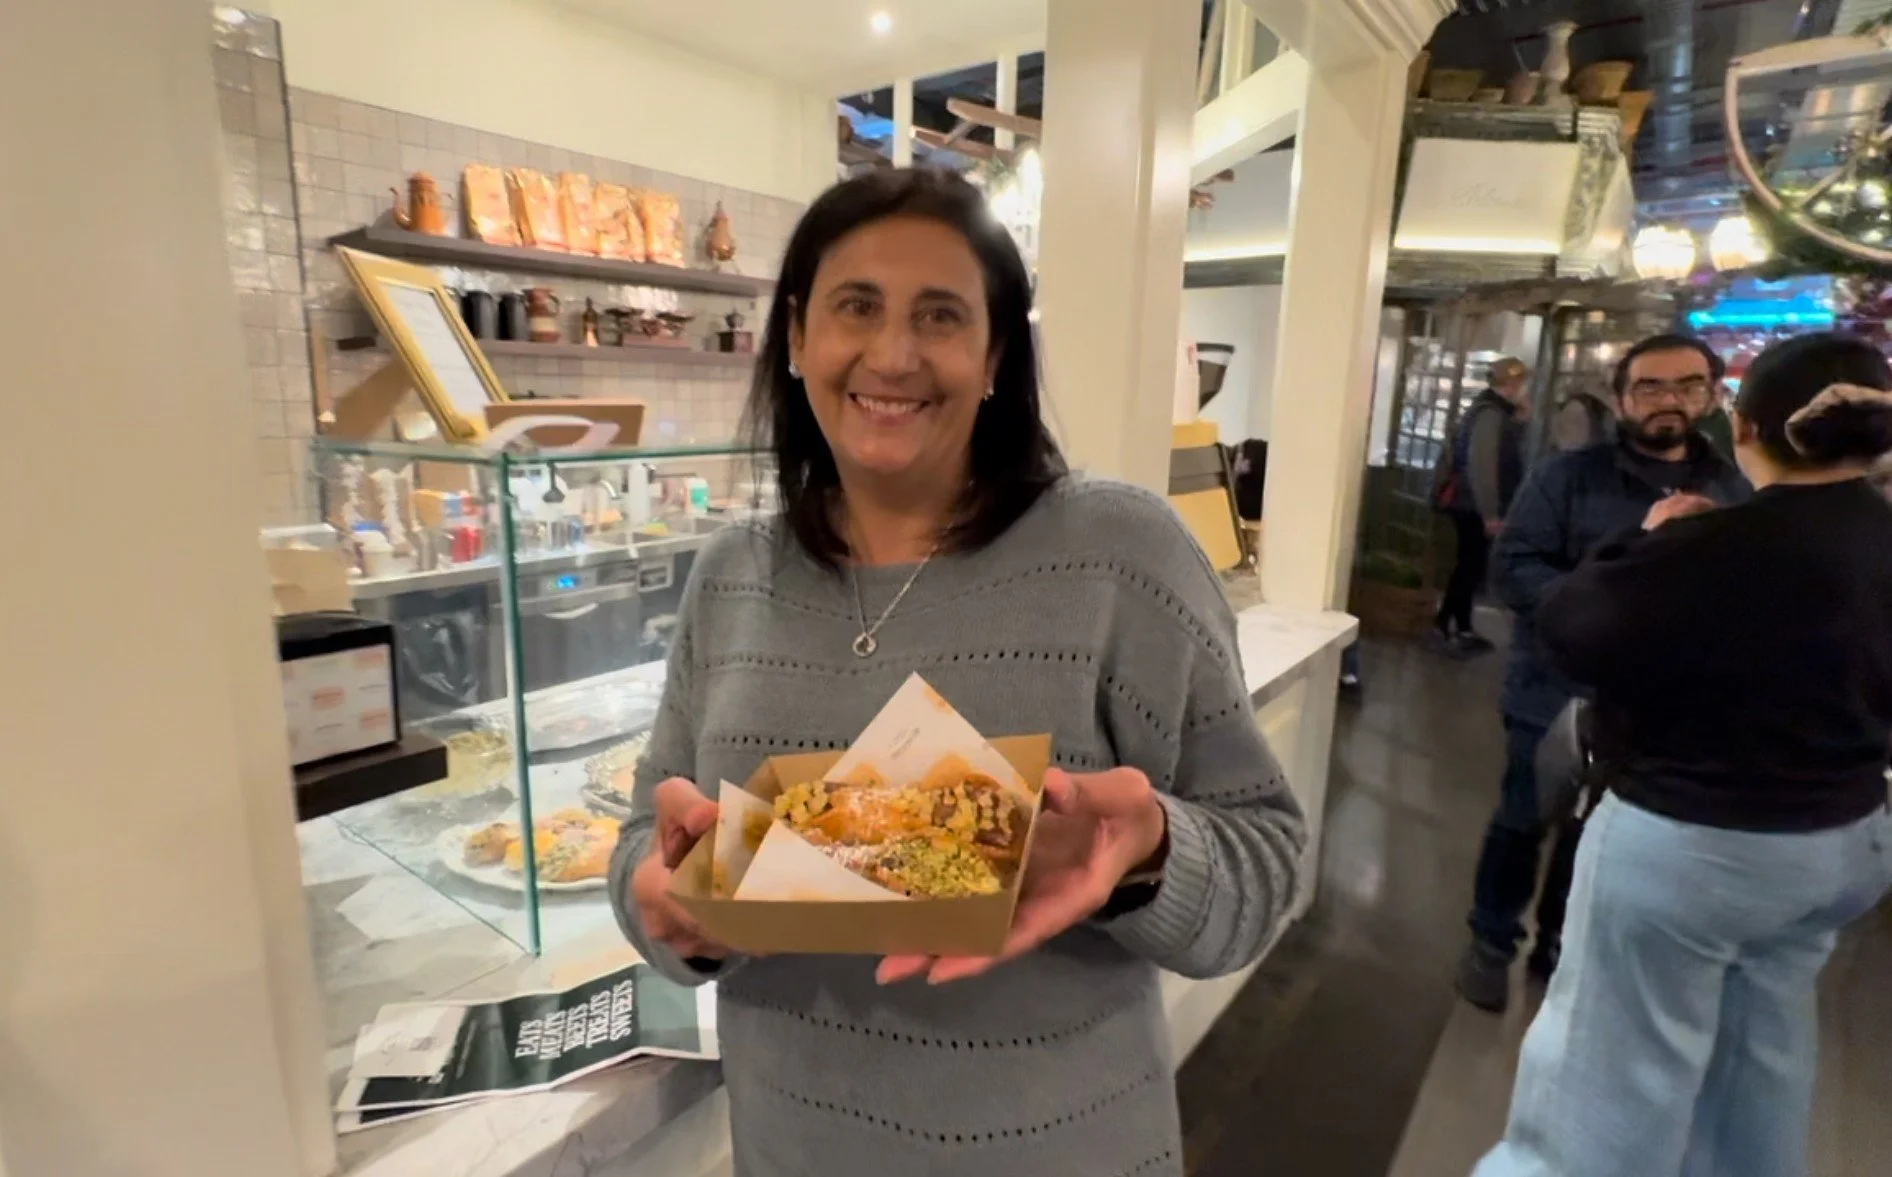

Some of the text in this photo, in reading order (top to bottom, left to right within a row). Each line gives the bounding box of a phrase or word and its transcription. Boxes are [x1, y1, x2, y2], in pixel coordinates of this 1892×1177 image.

[539, 1010, 566, 1060] MEATS
[585, 990, 611, 1048] TREATS
[610, 979, 632, 1041] SWEETS
[515, 1019, 542, 1058] EATS
